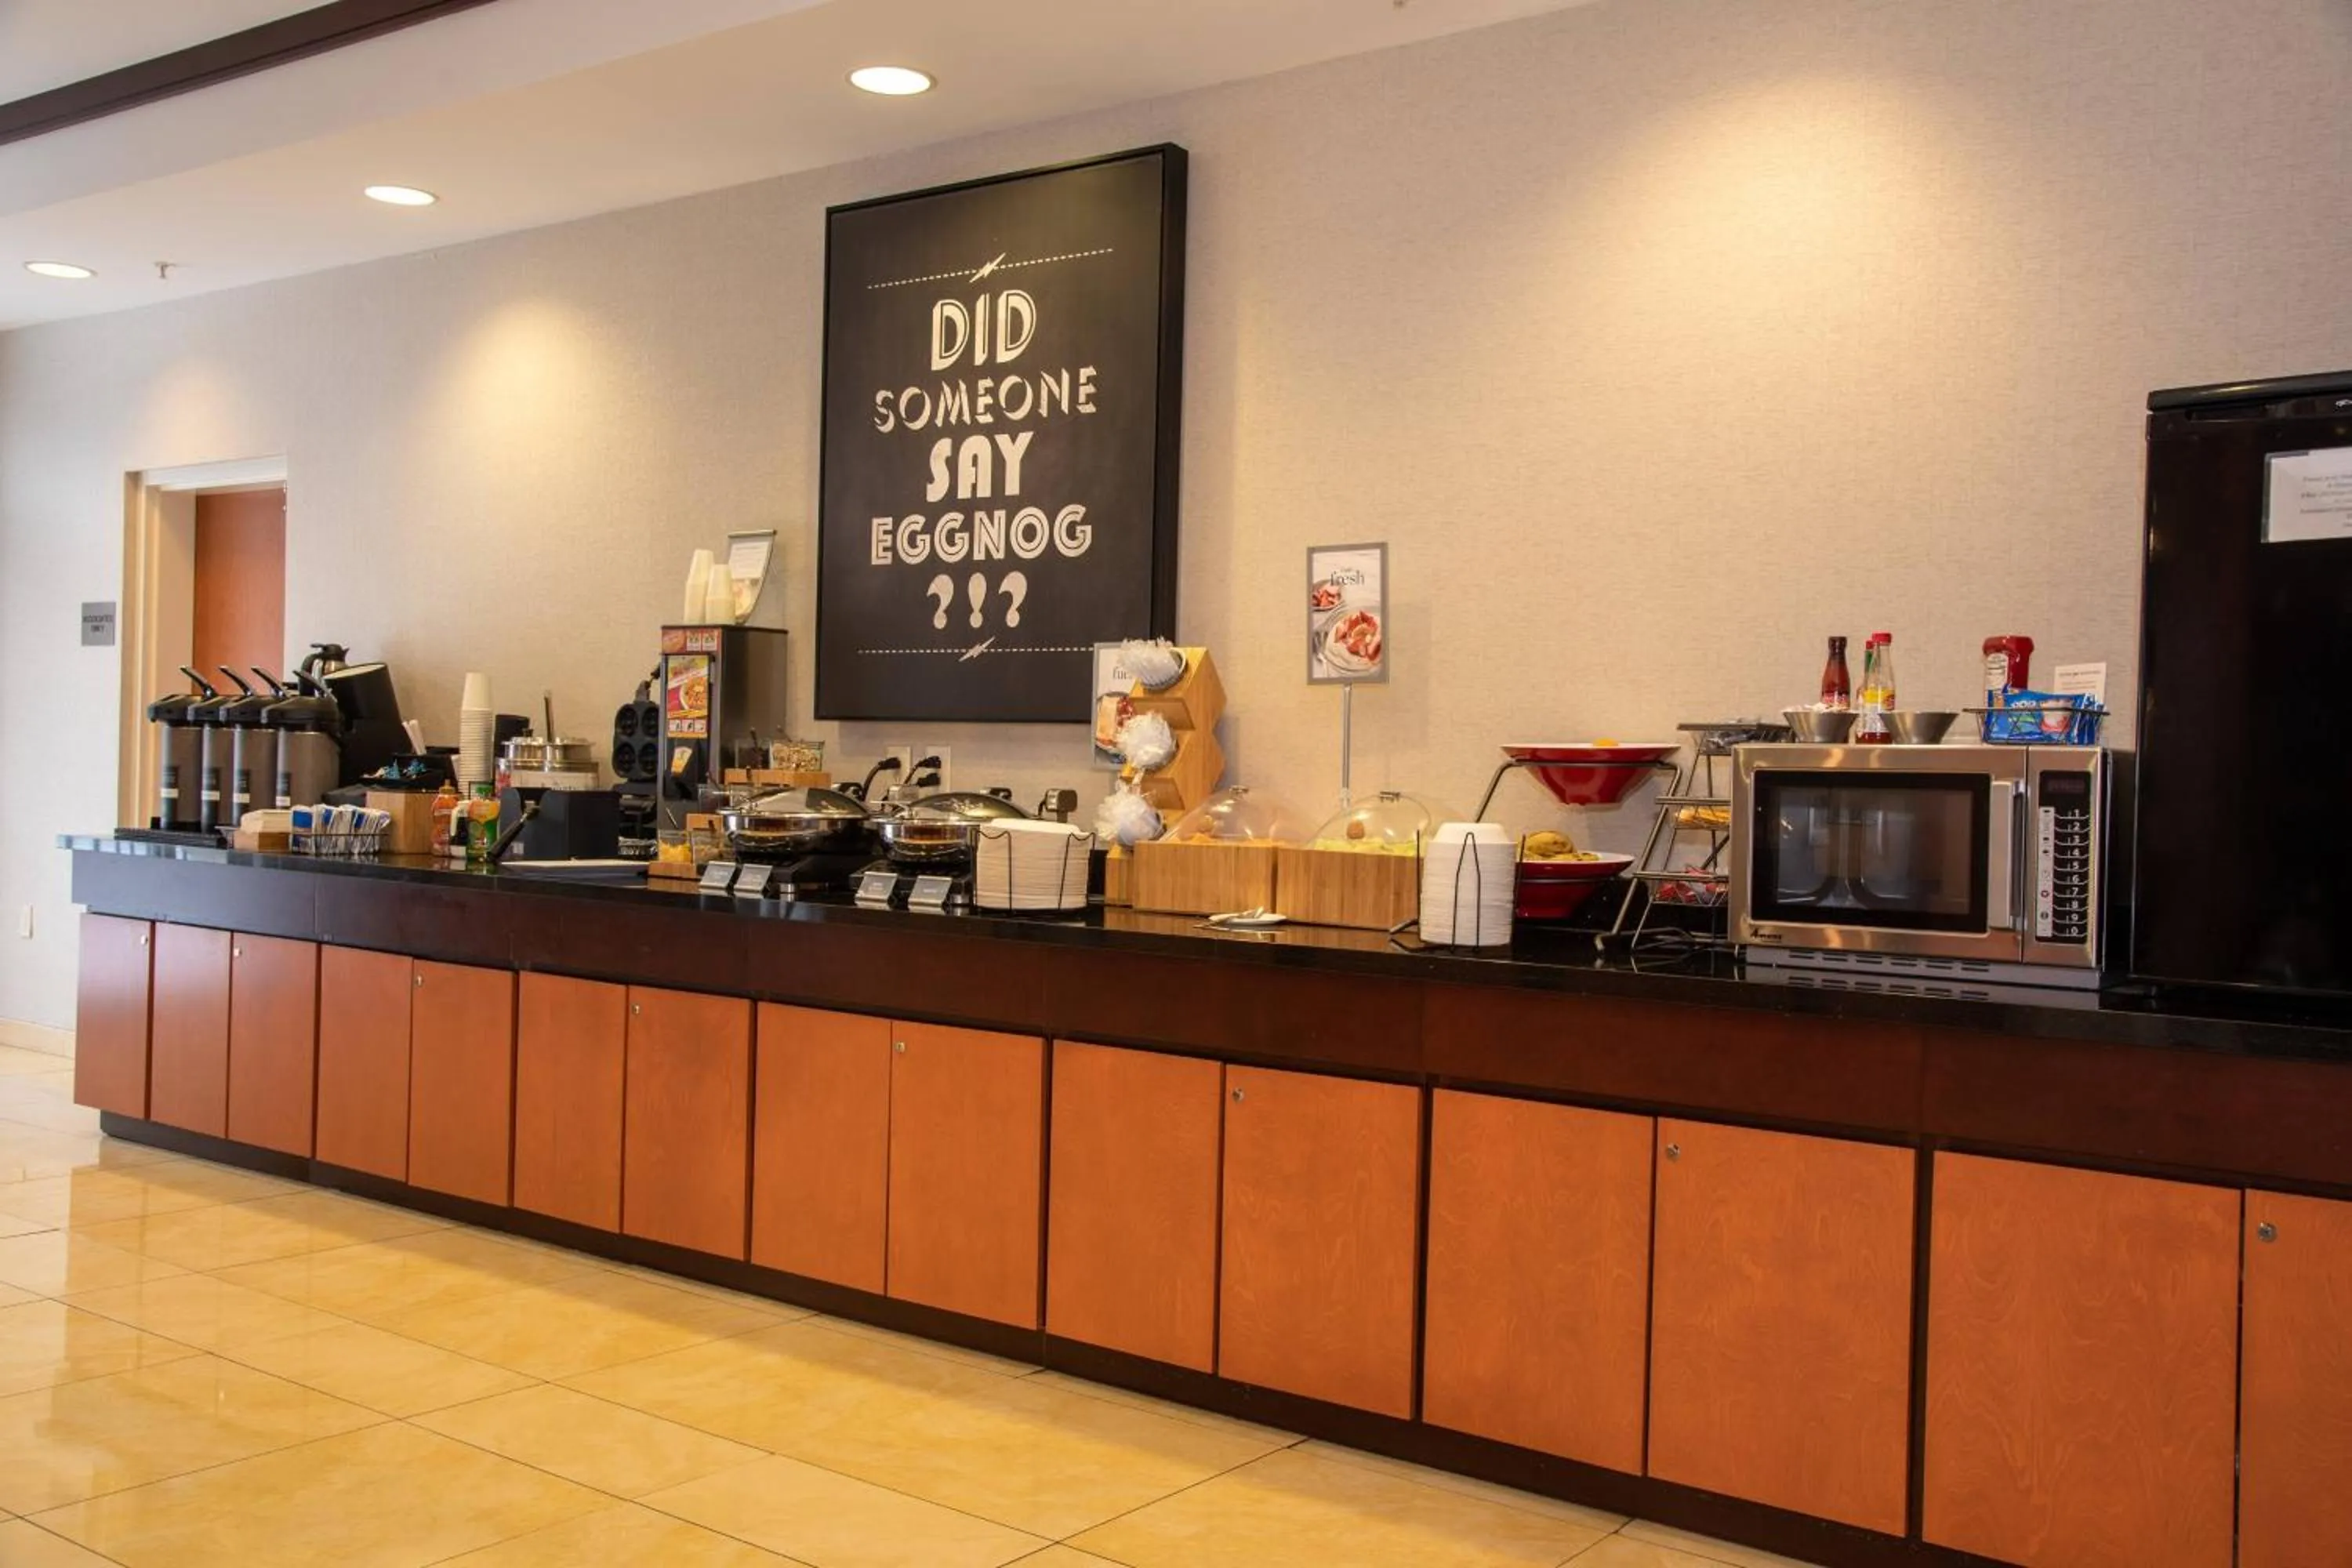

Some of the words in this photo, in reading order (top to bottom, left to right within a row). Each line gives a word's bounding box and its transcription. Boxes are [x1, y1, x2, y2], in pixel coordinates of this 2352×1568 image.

[931, 289, 1036, 371] DID
[874, 365, 1097, 432] SOMEONE
[926, 431, 1034, 503] SAY
[871, 504, 1092, 565] EGGNOG
[1330, 569, 1365, 586] fresh
